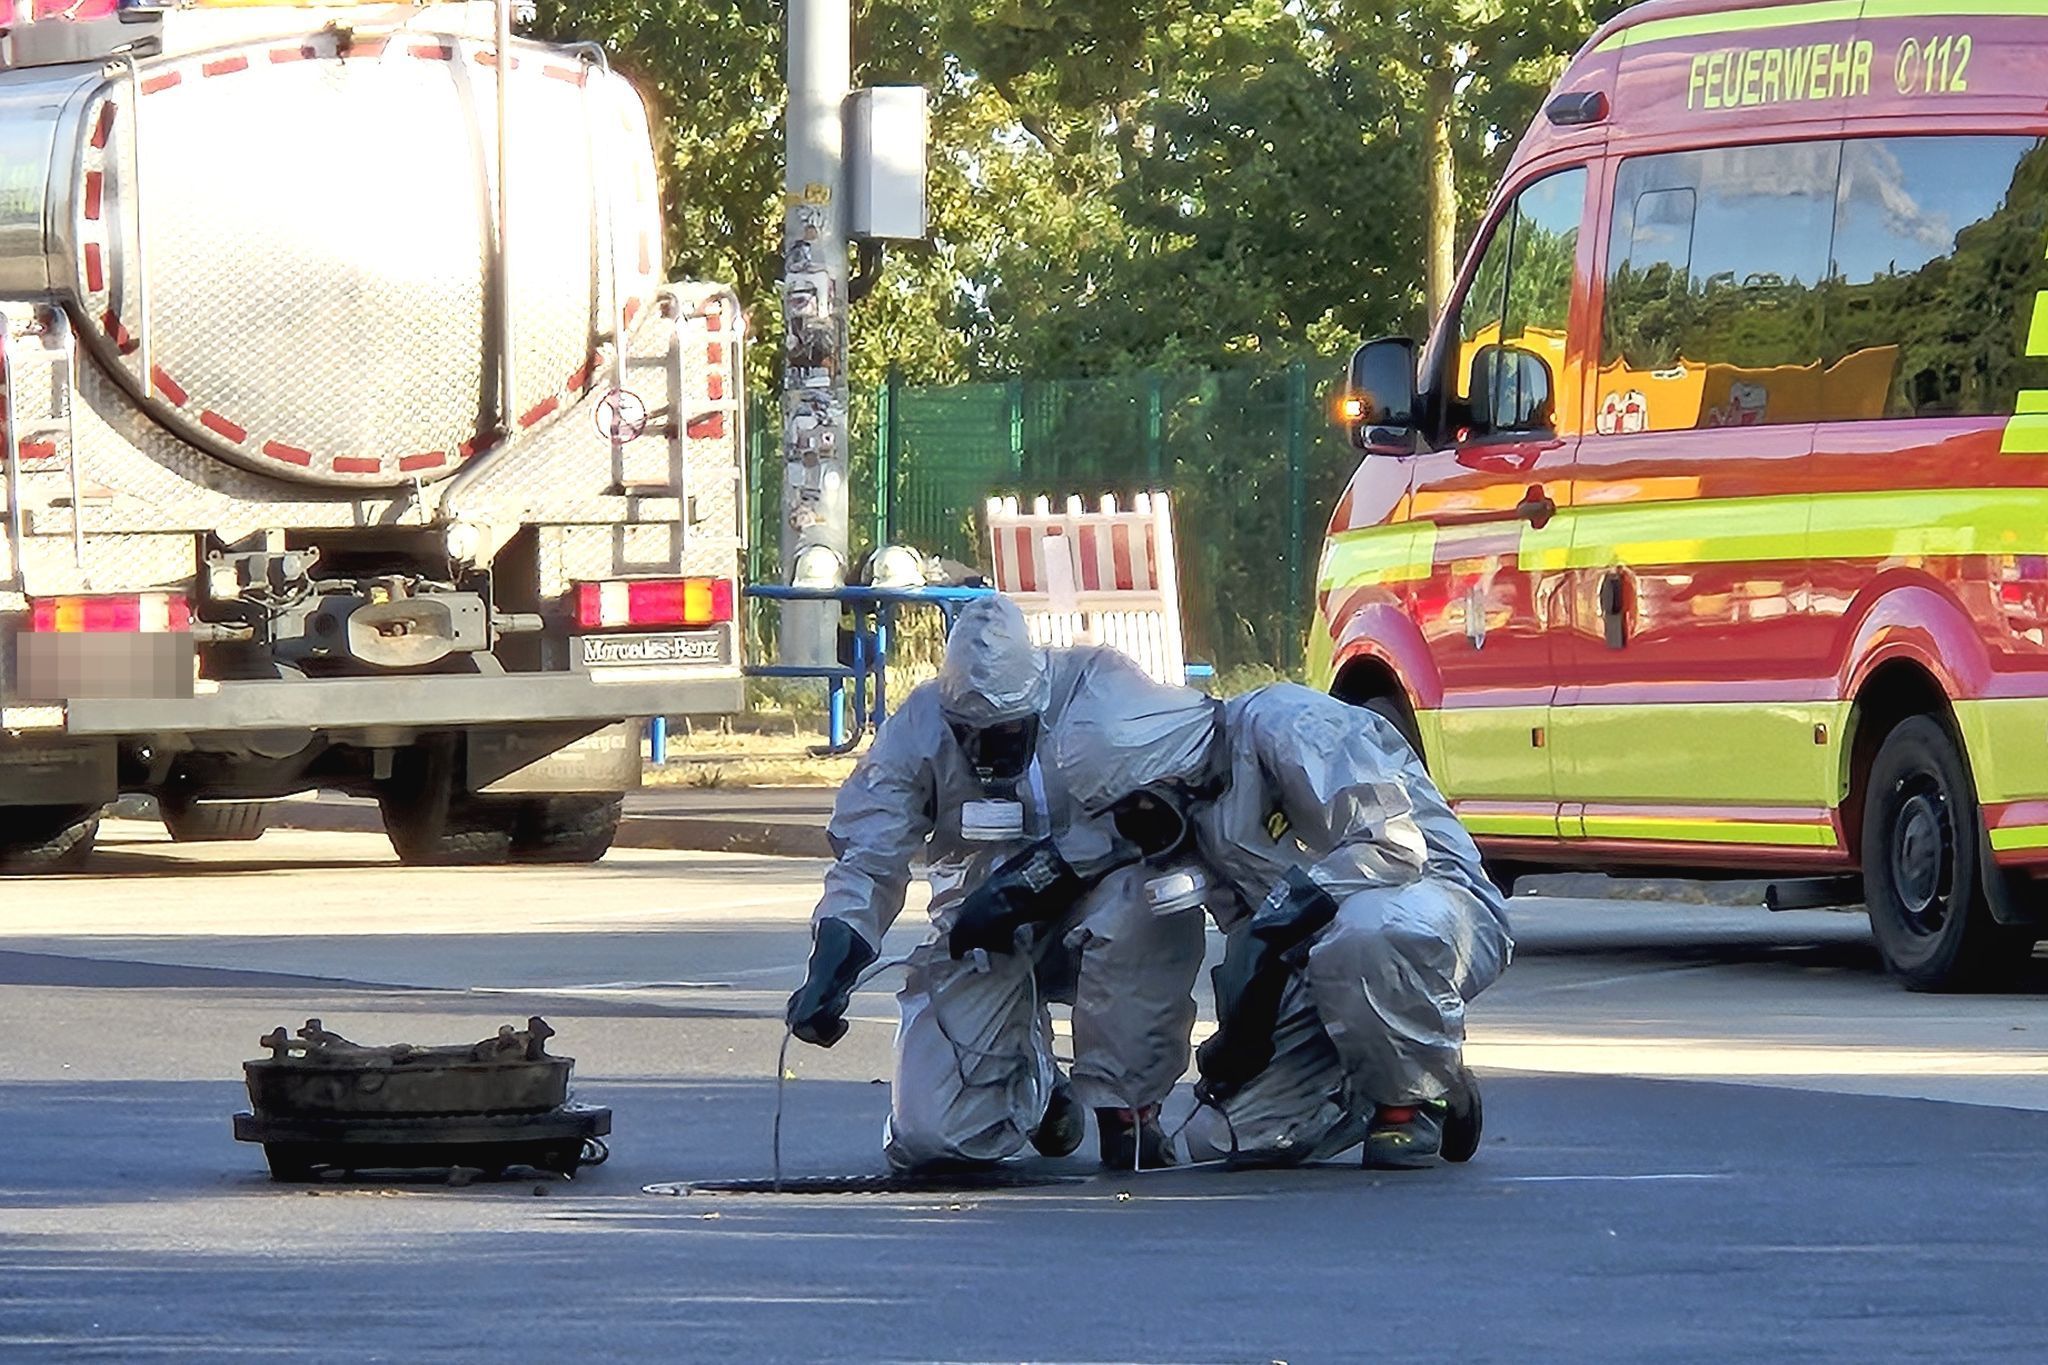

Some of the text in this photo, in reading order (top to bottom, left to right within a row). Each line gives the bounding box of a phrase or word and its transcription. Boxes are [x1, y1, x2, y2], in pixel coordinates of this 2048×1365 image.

[1687, 34, 1973, 110] FEUERWEHR 112
[584, 637, 719, 662] Mercedes-Benz
